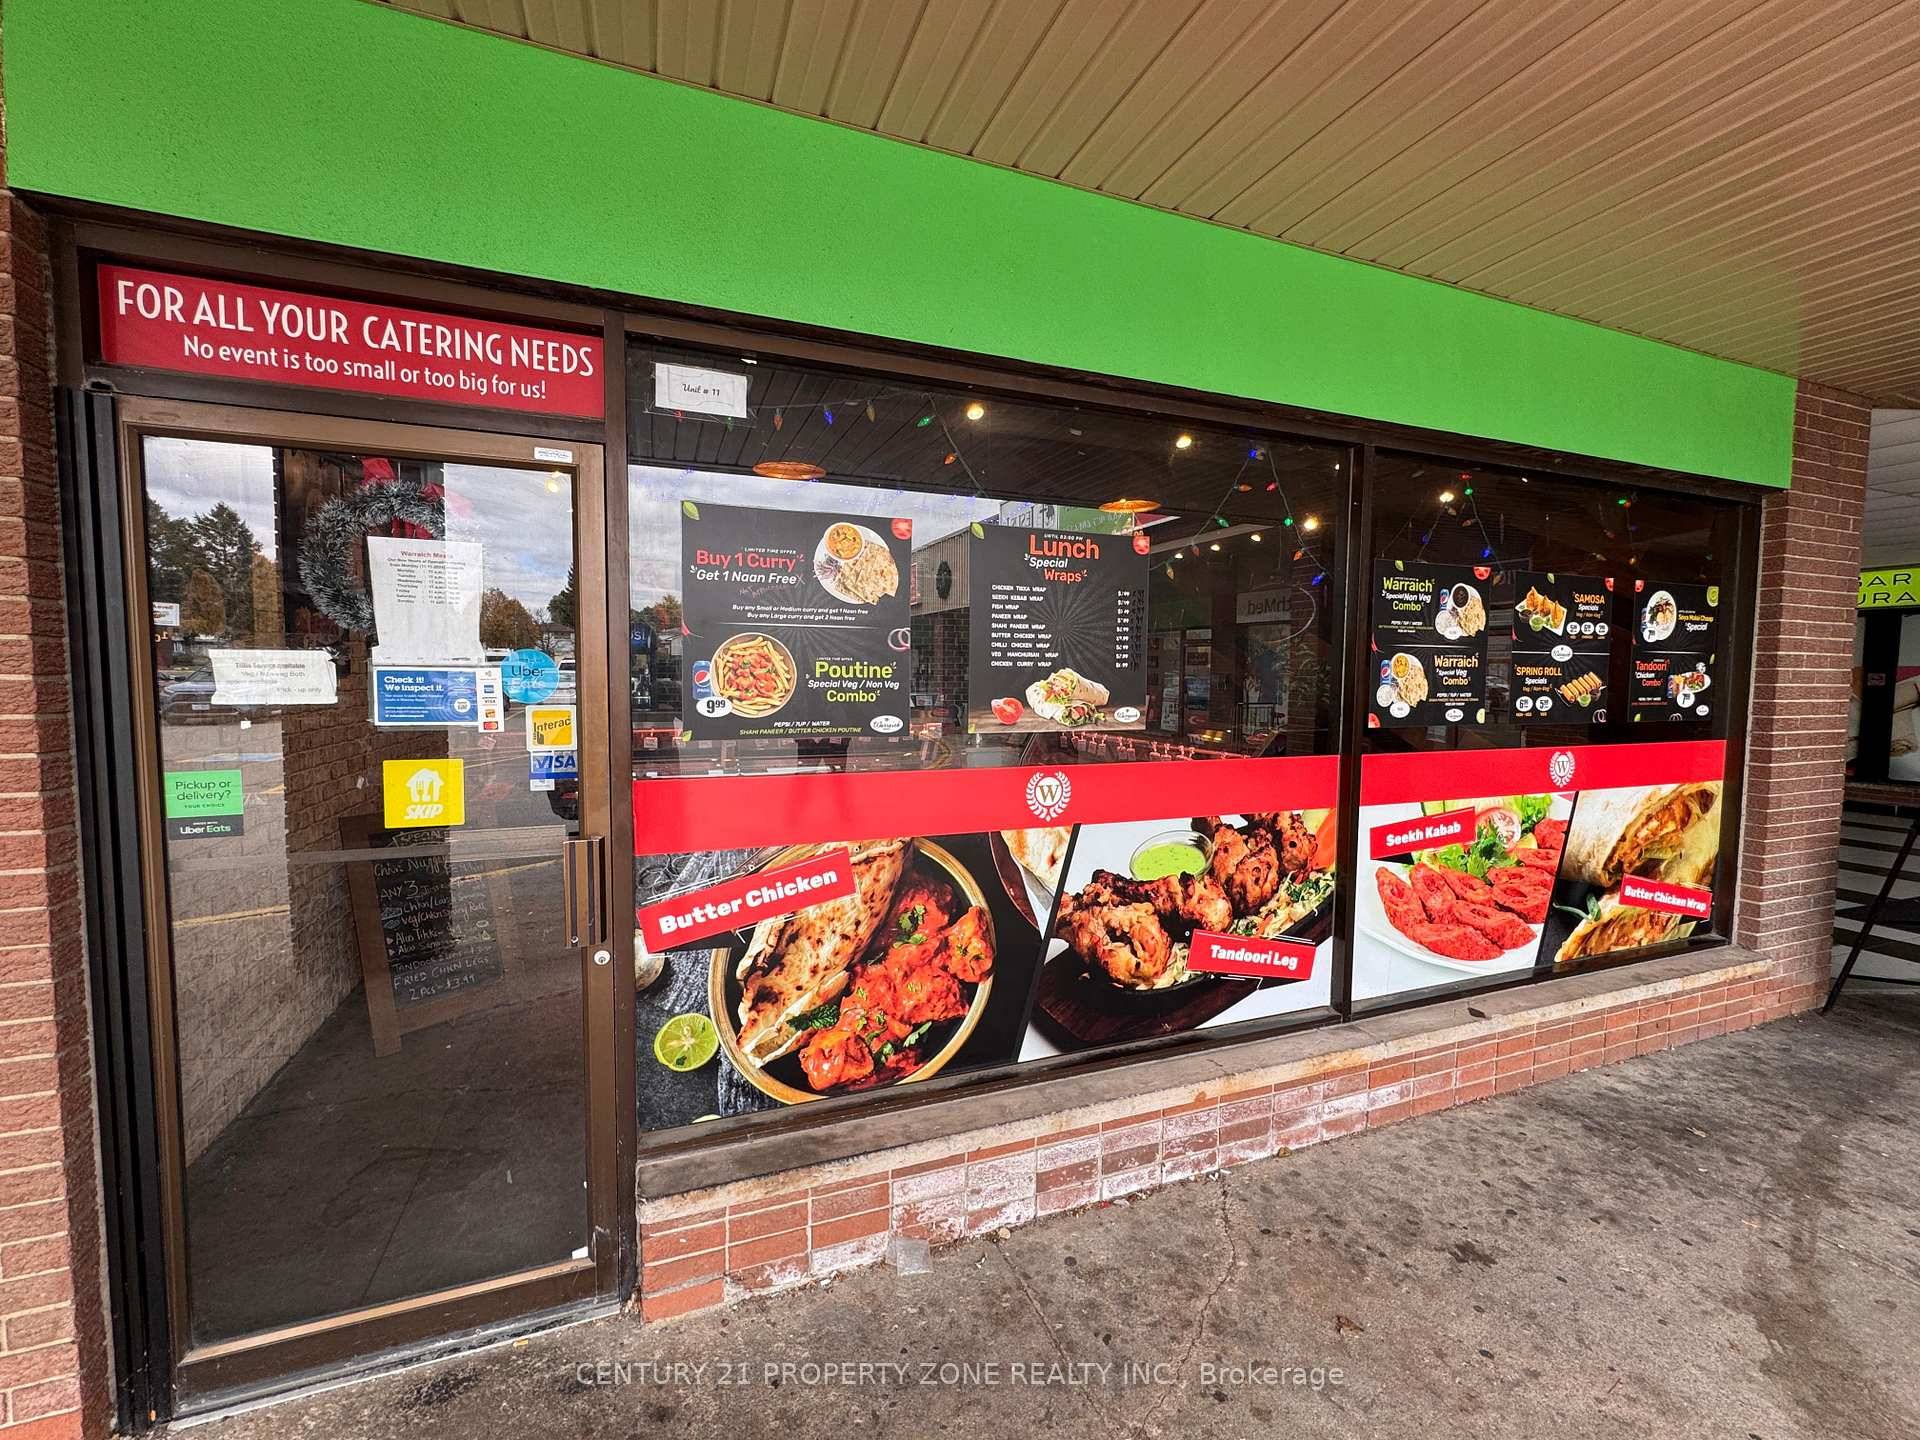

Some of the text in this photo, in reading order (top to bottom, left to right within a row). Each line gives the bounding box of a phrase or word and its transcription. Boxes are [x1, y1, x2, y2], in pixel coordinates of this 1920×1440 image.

[118, 280, 594, 377] FOR ALL YOUR CATERING NEEDS
[184, 335, 547, 399] No event is too small or too big for us!
[1029, 534, 1099, 559] Lunch
[695, 550, 796, 572] Buy 1 Curry
[1028, 557, 1068, 570] Special
[696, 569, 797, 585] Get 1 Naan Free
[1044, 569, 1082, 584] Wraps
[1383, 576, 1433, 592] Warraich
[1404, 593, 1432, 603] Non Veg
[1574, 593, 1606, 605] SAMOSA
[1393, 600, 1422, 611] Combo
[1686, 622, 1709, 633] Special
[1434, 655, 1479, 668] Warraich
[1635, 660, 1667, 671] Tandoori
[511, 665, 545, 677] Uber
[815, 661, 893, 679] Poutine
[1455, 668, 1468, 677] Veg
[1516, 666, 1562, 676] SPRING ROLL
[1636, 671, 1655, 679] Chicken
[384, 675, 425, 684] Check it!
[808, 680, 841, 689] Special
[842, 680, 858, 689] Veg
[883, 681, 899, 690] Veg
[1442, 676, 1468, 685] Combo
[1525, 677, 1548, 685] Specials
[1642, 679, 1662, 687] Combo
[384, 684, 400, 692] We
[826, 690, 877, 702] Combo
[533, 716, 571, 733] Interac
[535, 755, 576, 769] VISA
[1557, 760, 1569, 772] W
[175, 780, 231, 790] Pickup or
[176, 790, 232, 801] delivery?
[1039, 784, 1060, 802] W
[404, 804, 444, 820] SKIP
[180, 825, 231, 834] Uber Eats
[1386, 821, 1462, 847] Seekh Kabab
[404, 880, 419, 896] 3
[659, 870, 838, 935] Butter Chicken
[1624, 885, 1707, 912] Butter Chicken Wrap
[1210, 944, 1299, 971] Tandoori Leg
